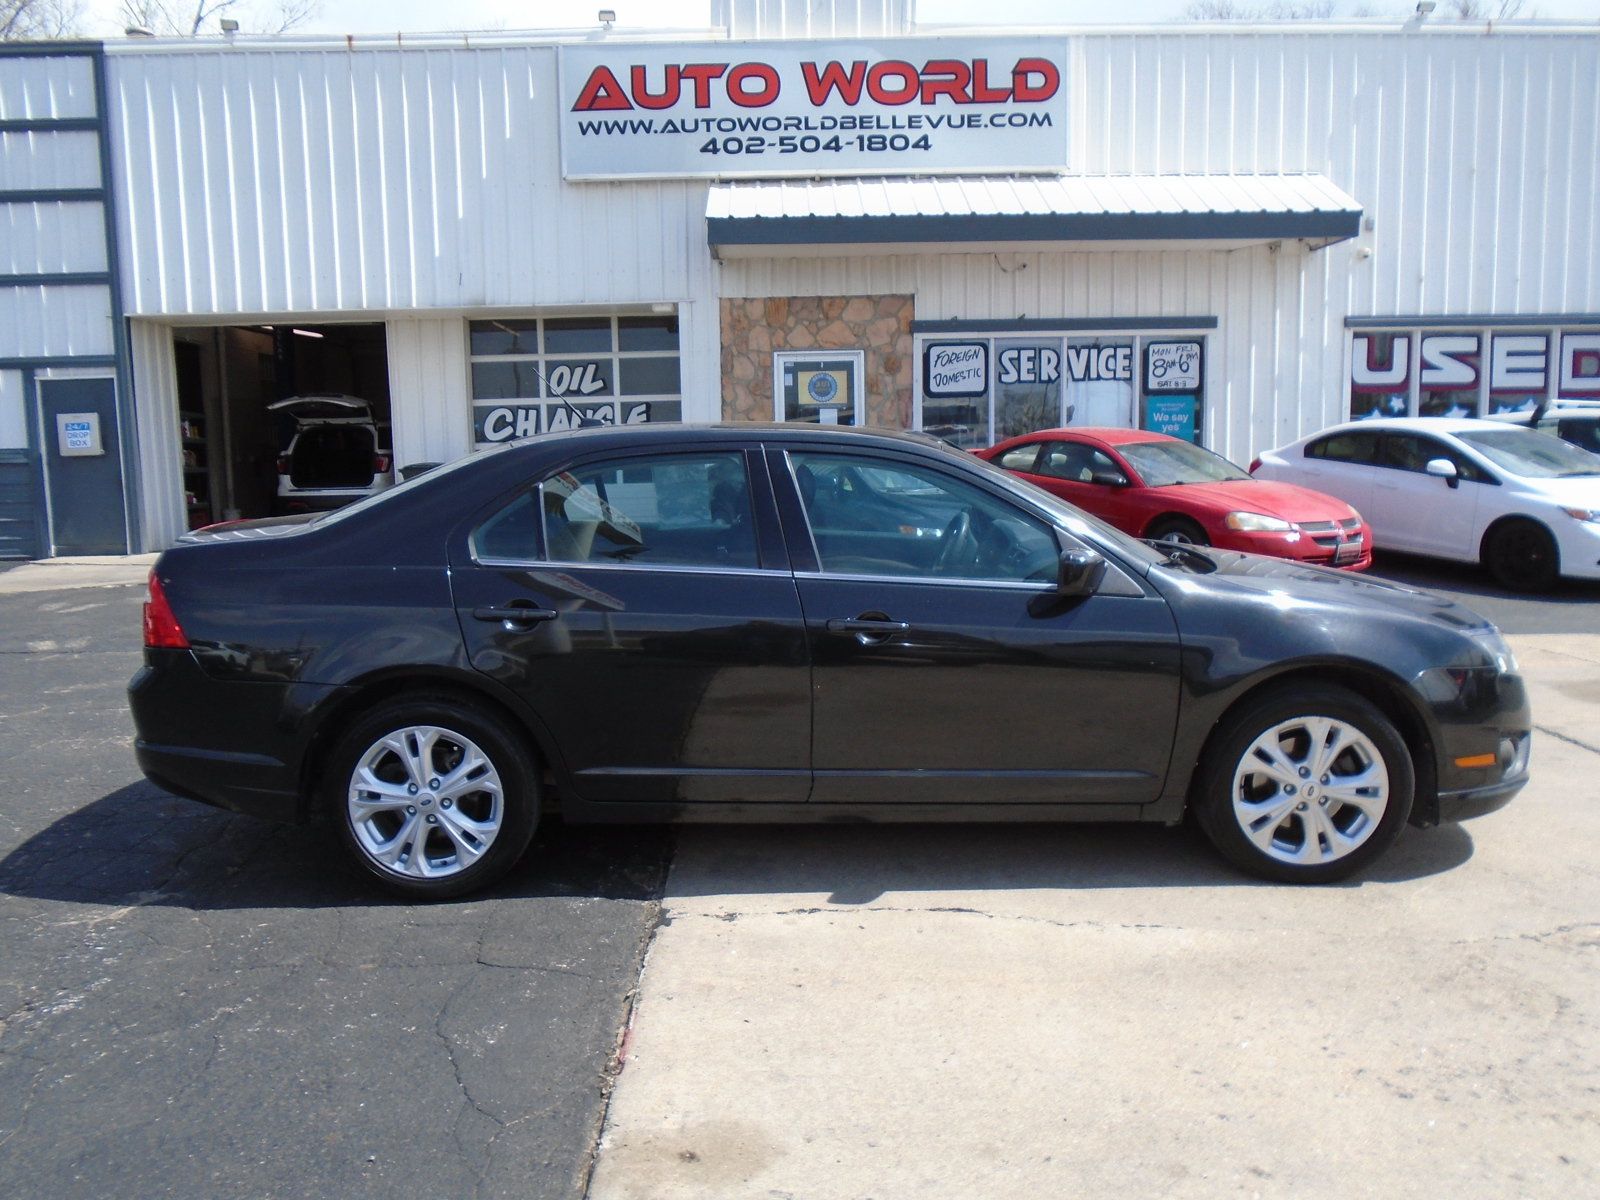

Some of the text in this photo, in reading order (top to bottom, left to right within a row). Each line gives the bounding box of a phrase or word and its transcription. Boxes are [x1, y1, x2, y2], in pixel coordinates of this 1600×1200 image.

[570, 57, 1060, 112] AUTO WORLD
[578, 112, 1053, 136] WWW.AUTOWORLDBELLEVUE.COM
[699, 133, 933, 155] 402-504-1804
[934, 347, 981, 368] FOREIGN
[999, 345, 1133, 384] SERVICE
[1351, 334, 1600, 391] USED
[549, 363, 605, 396] OIL
[932, 367, 982, 387] DOMESTIC
[1153, 412, 1169, 422] We
